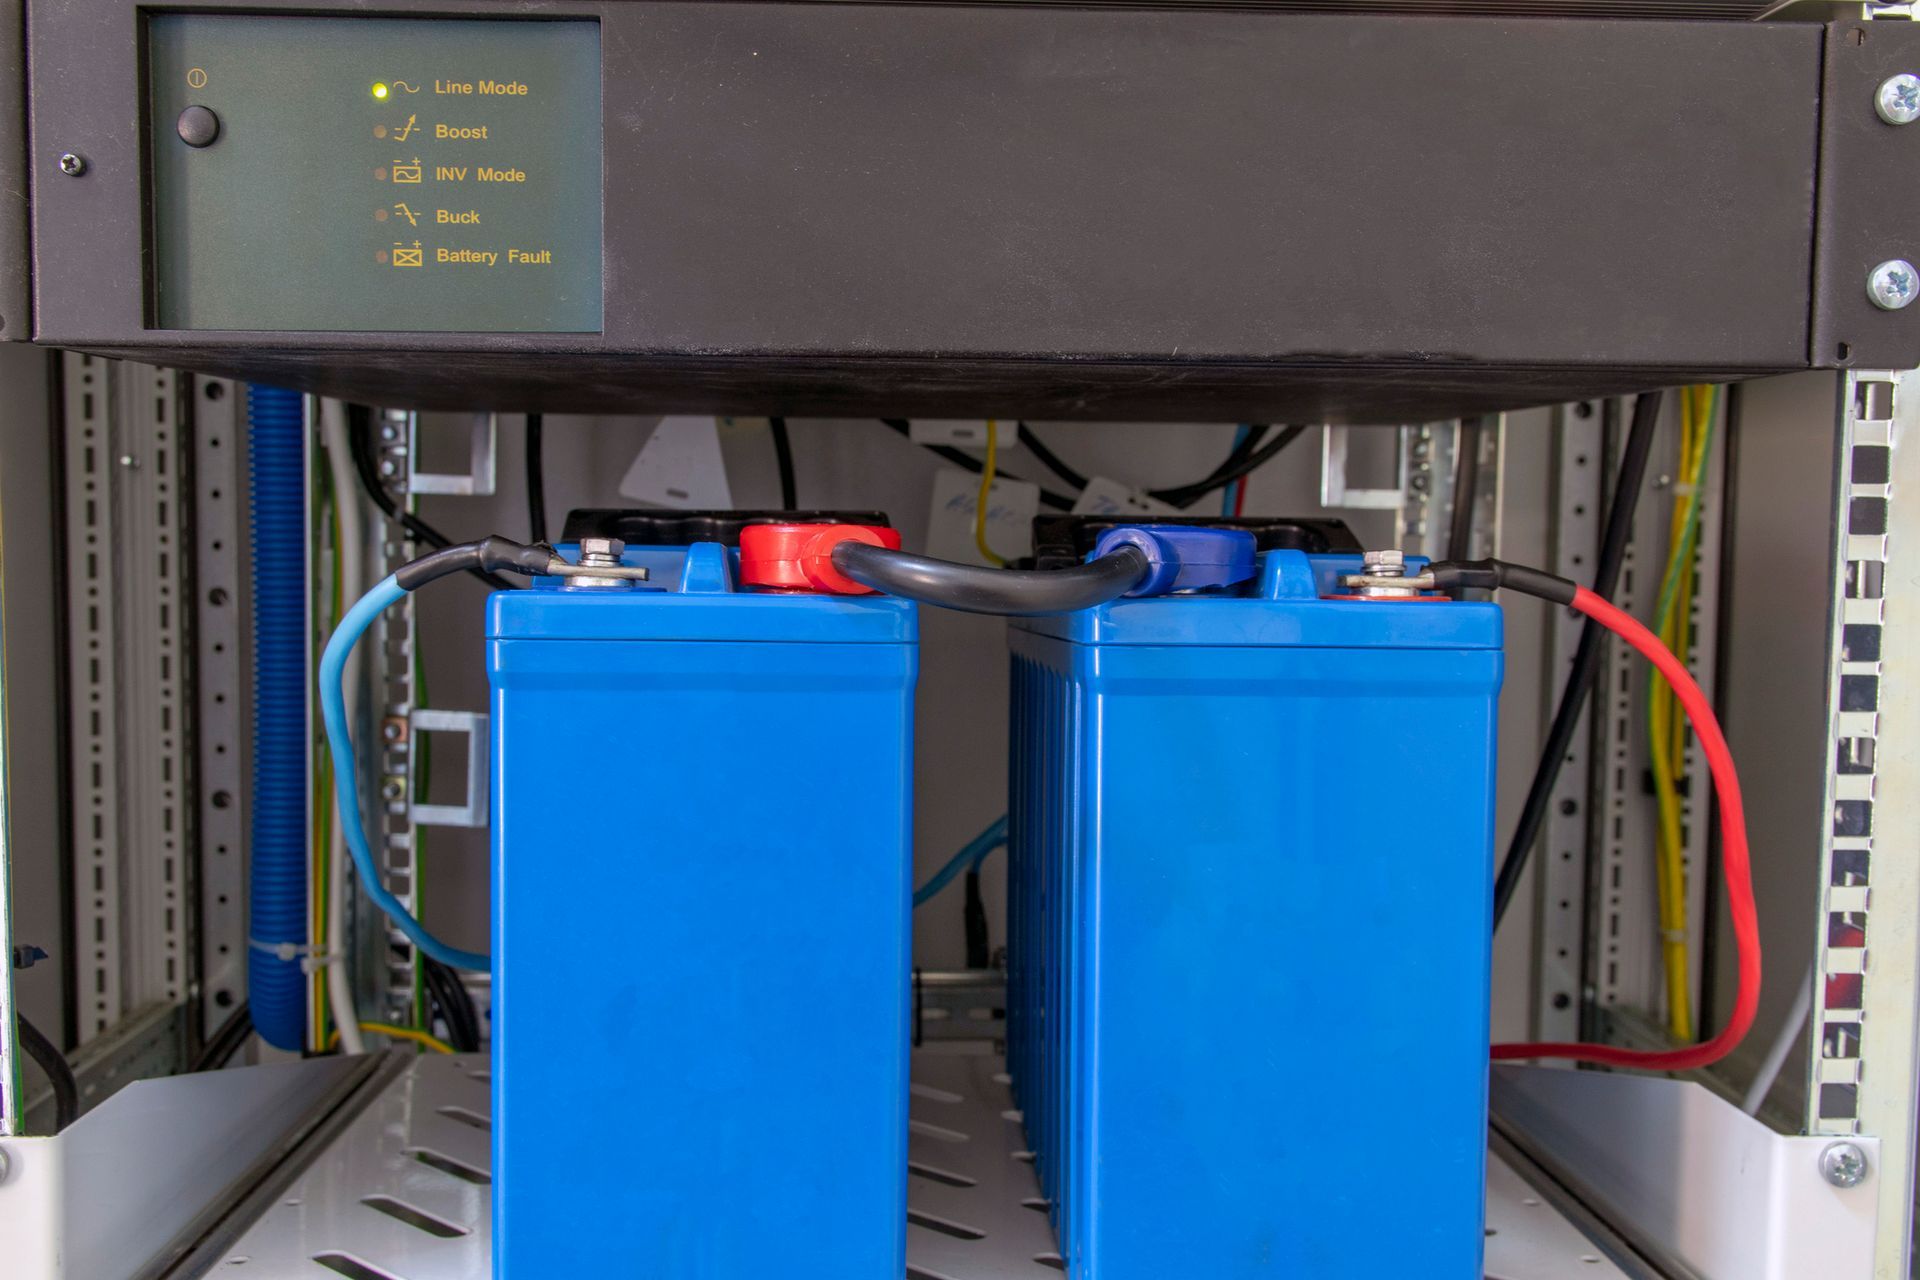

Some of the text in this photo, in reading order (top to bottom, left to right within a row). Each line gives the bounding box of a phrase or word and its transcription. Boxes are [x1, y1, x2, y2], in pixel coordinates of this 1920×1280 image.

[435, 80, 528, 96] Line Mode
[435, 123, 488, 140] Boost
[435, 166, 526, 183] INV Mode
[436, 208, 480, 224] Buck
[436, 247, 552, 267] Battery Fault
